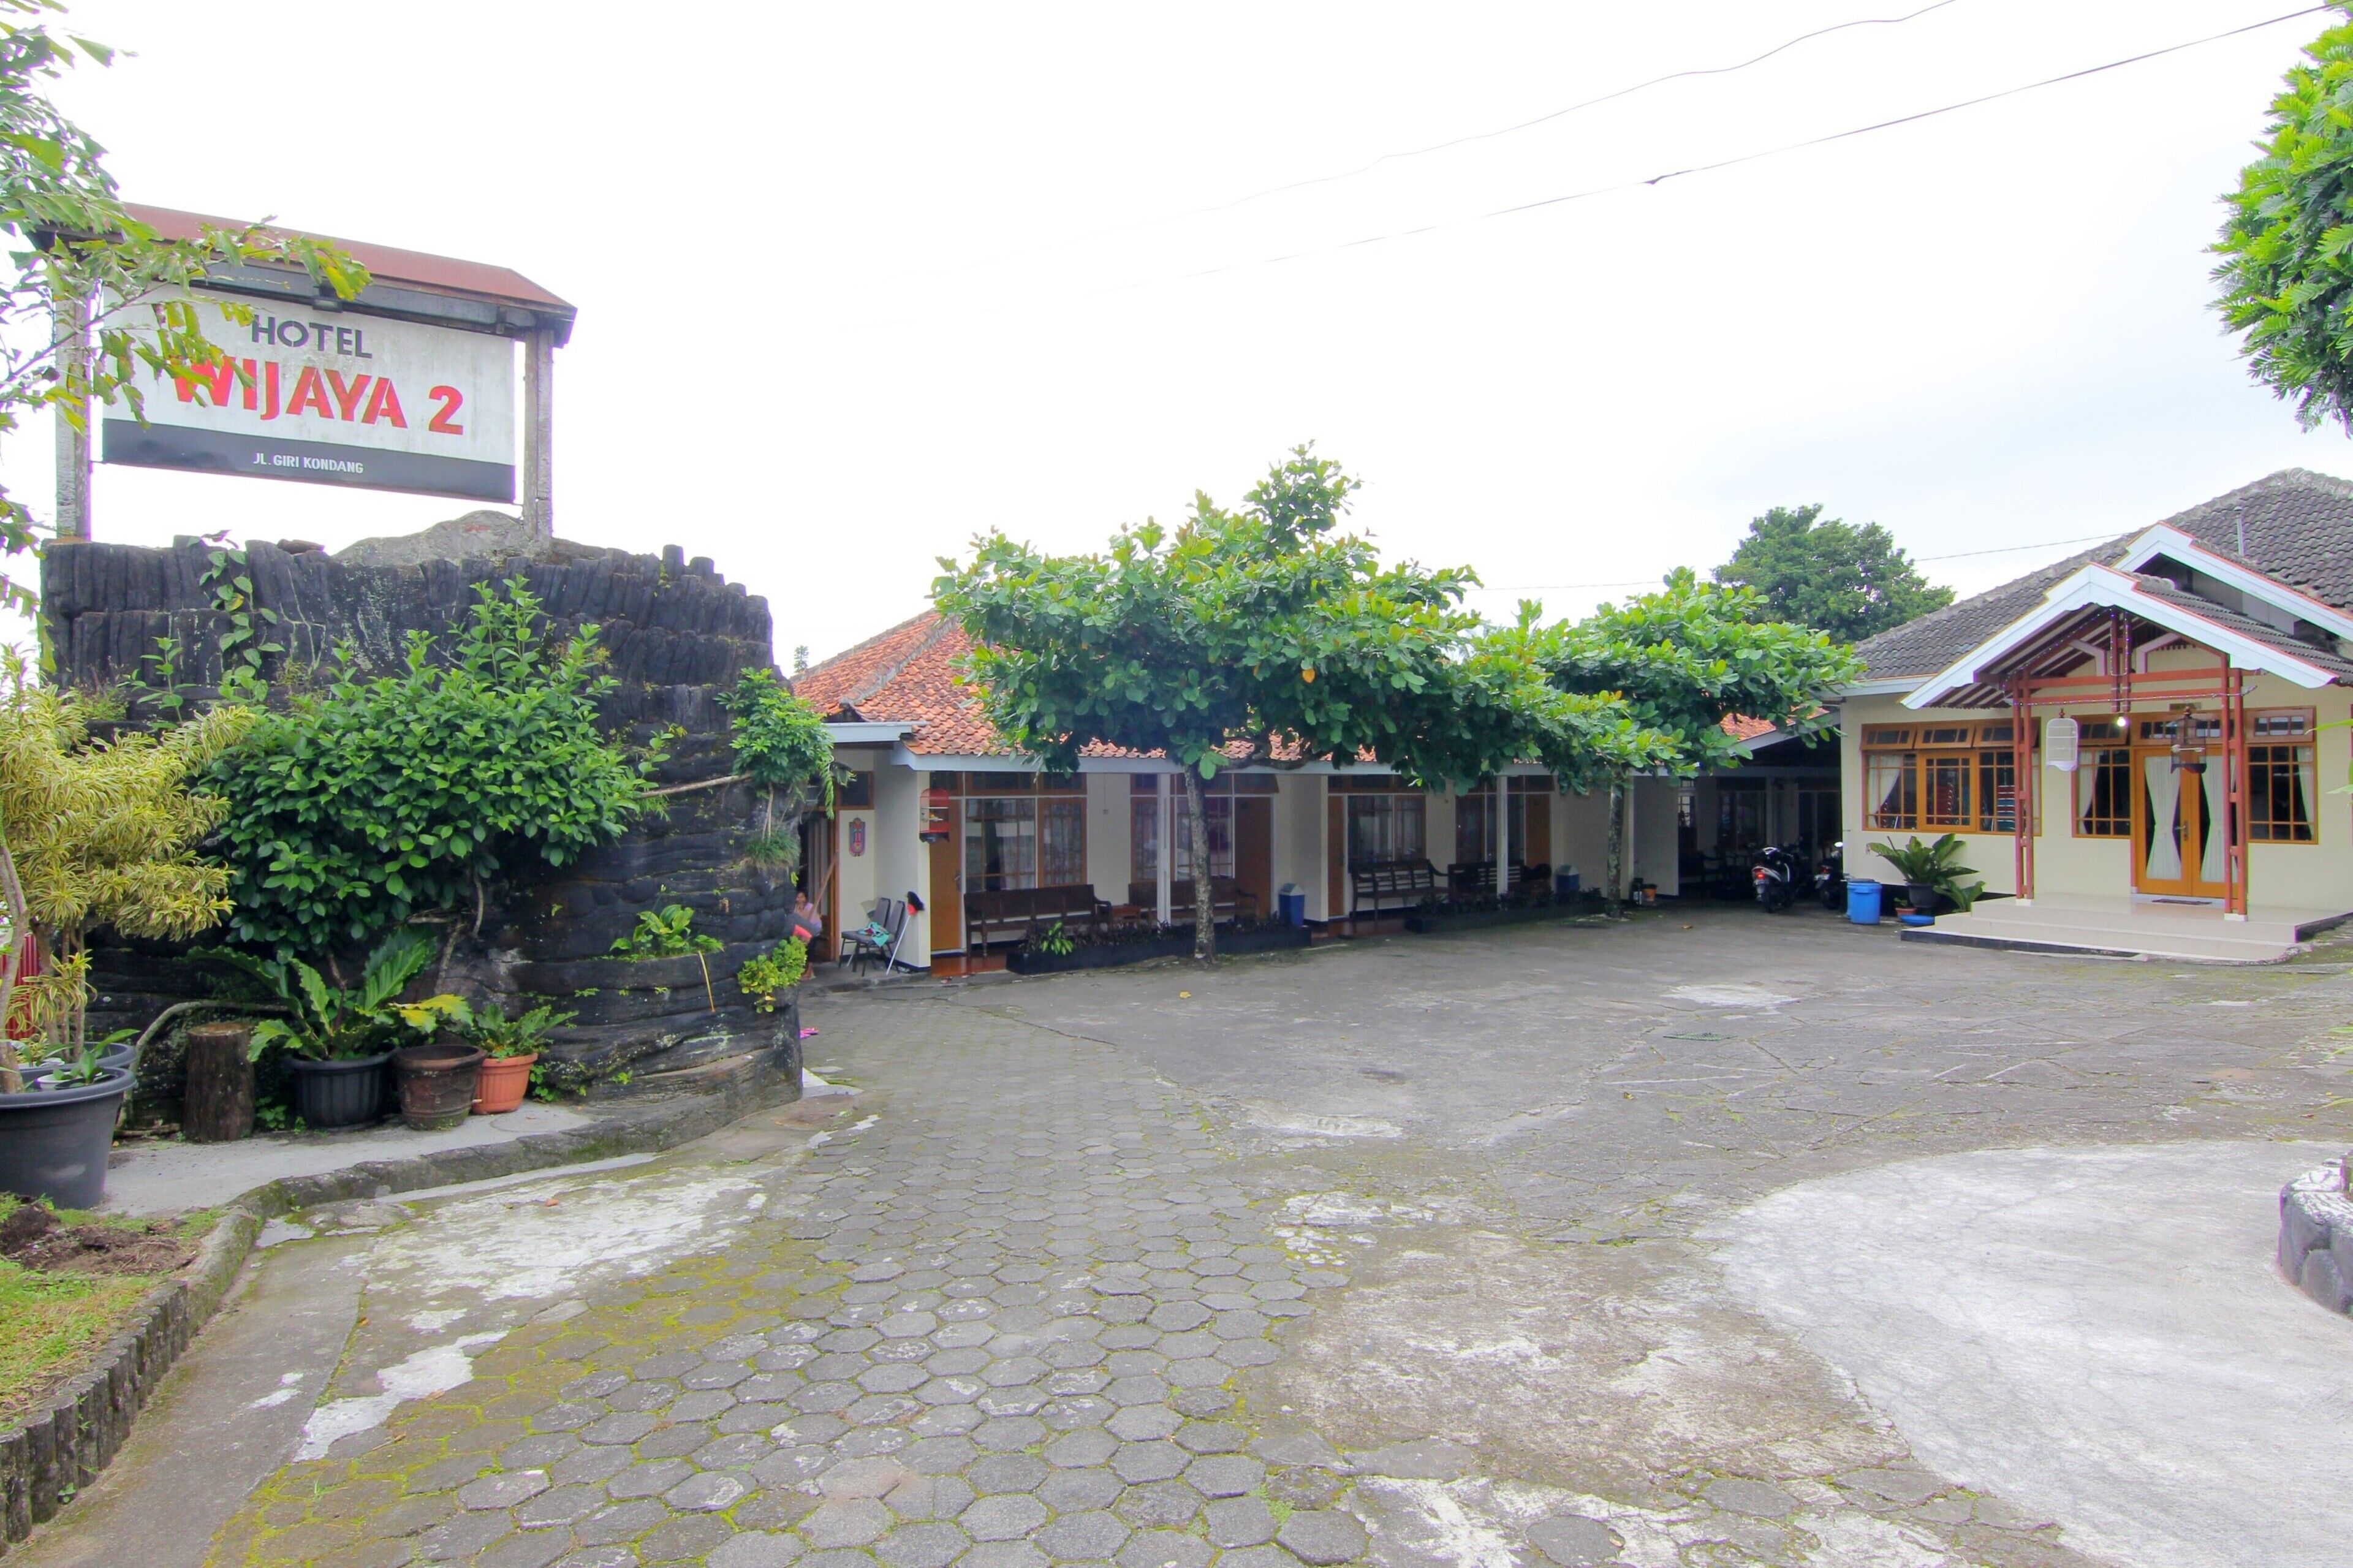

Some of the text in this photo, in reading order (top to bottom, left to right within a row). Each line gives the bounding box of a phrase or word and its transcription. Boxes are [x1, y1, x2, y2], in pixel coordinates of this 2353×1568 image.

[251, 314, 373, 359] HOTEL
[167, 354, 464, 435] WIJAYA 2
[253, 452, 363, 474] JL. GIRI KONDANG
